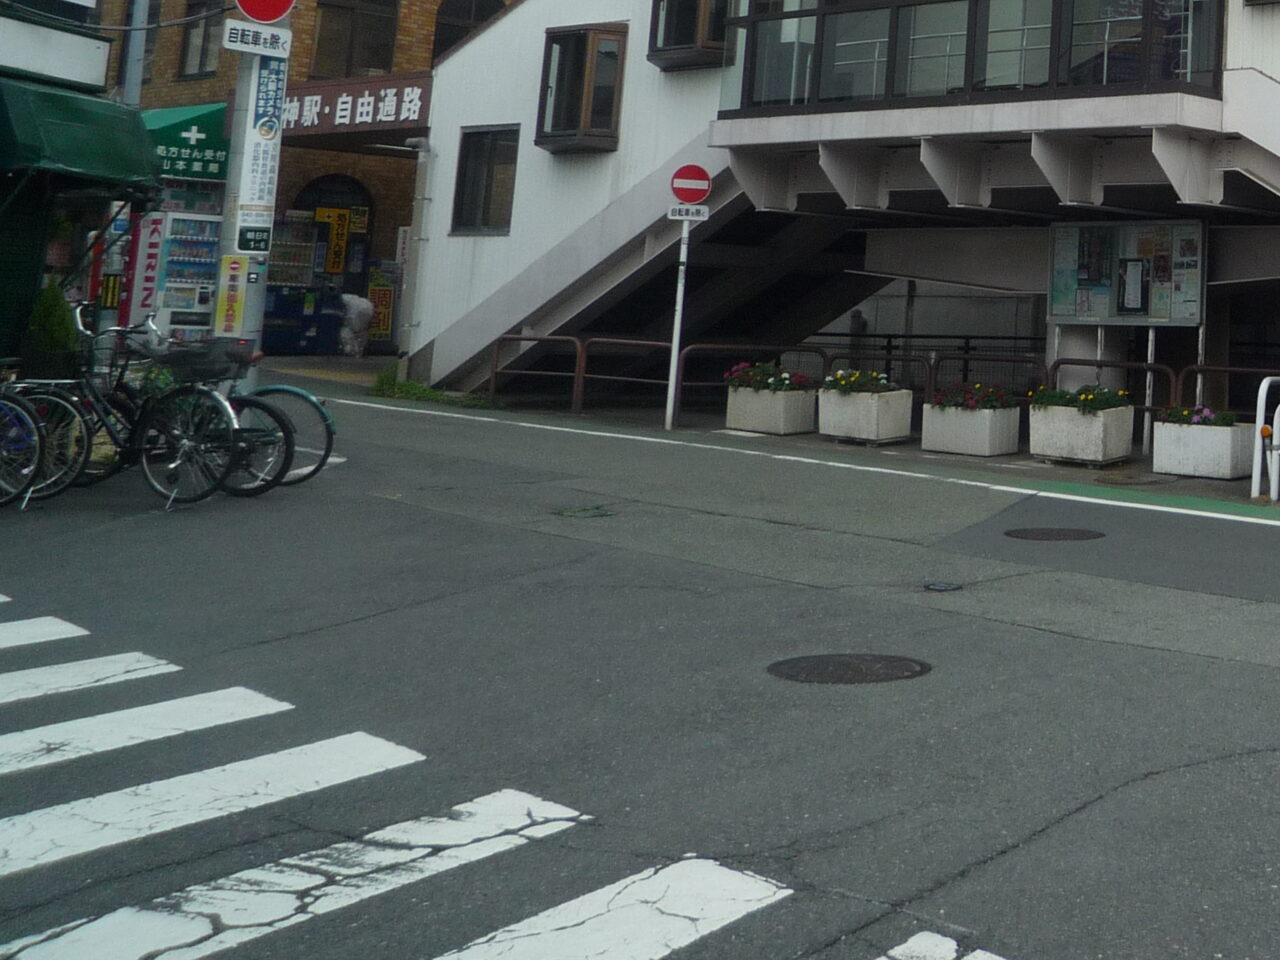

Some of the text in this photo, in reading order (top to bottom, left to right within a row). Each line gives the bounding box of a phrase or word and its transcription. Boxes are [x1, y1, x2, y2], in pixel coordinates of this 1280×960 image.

[228, 27, 288, 52] 自転車を除く
[156, 145, 227, 162] 処方せん受付
[140, 218, 163, 309] KIRIN
